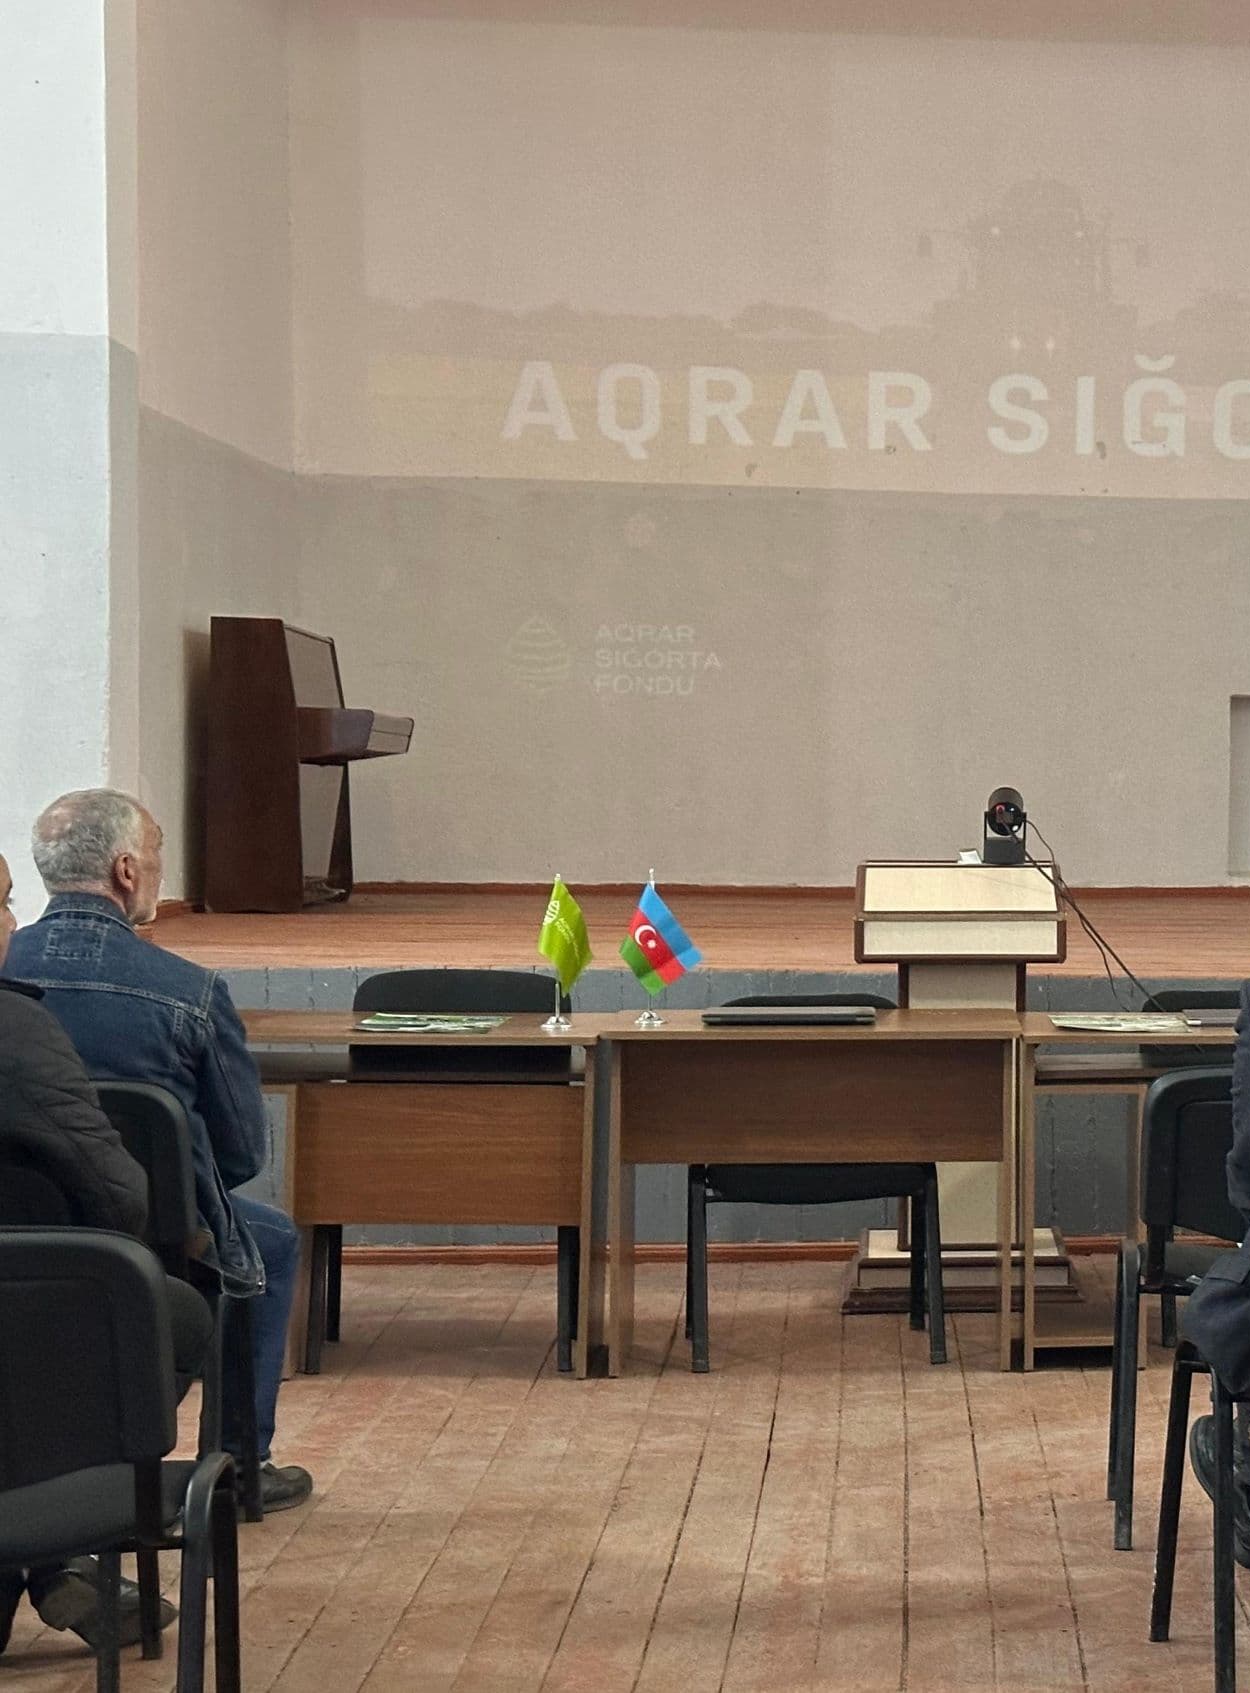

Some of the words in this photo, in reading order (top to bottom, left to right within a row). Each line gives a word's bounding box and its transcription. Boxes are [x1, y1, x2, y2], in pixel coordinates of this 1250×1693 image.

[500, 360, 933, 460] AQRAR
[594, 624, 696, 644] AQRAR
[593, 673, 696, 696] FONDU
